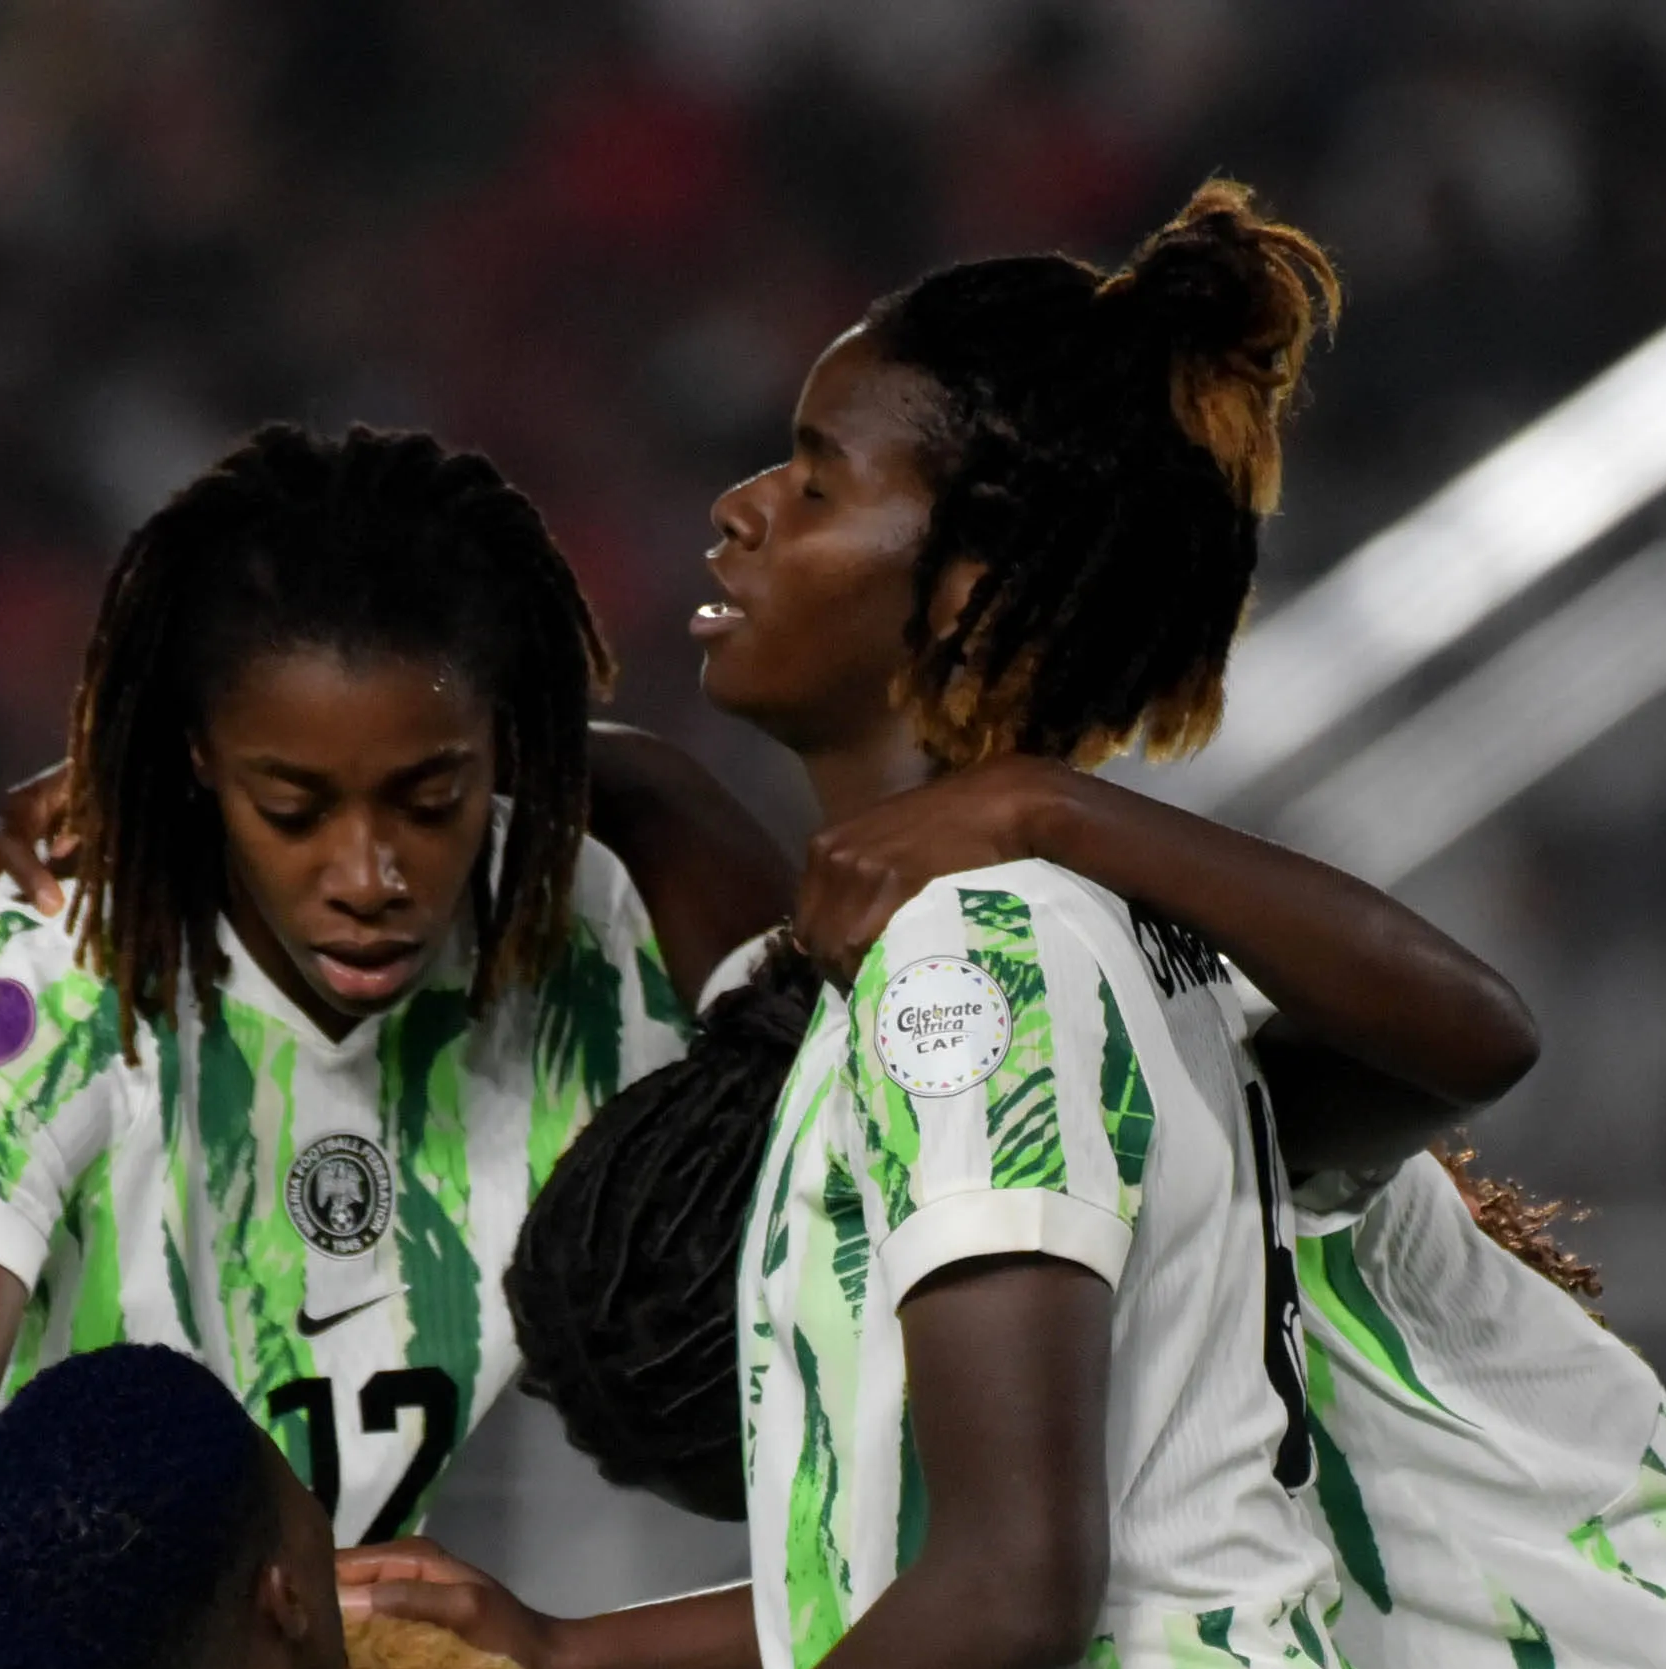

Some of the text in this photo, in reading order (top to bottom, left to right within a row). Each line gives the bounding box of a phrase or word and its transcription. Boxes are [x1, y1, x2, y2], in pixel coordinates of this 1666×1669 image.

[897, 1002, 982, 1032] Celebrate
[911, 1019, 964, 1041] Africa
[916, 1036, 964, 1054] CAF
[266, 1367, 459, 1547] 12
